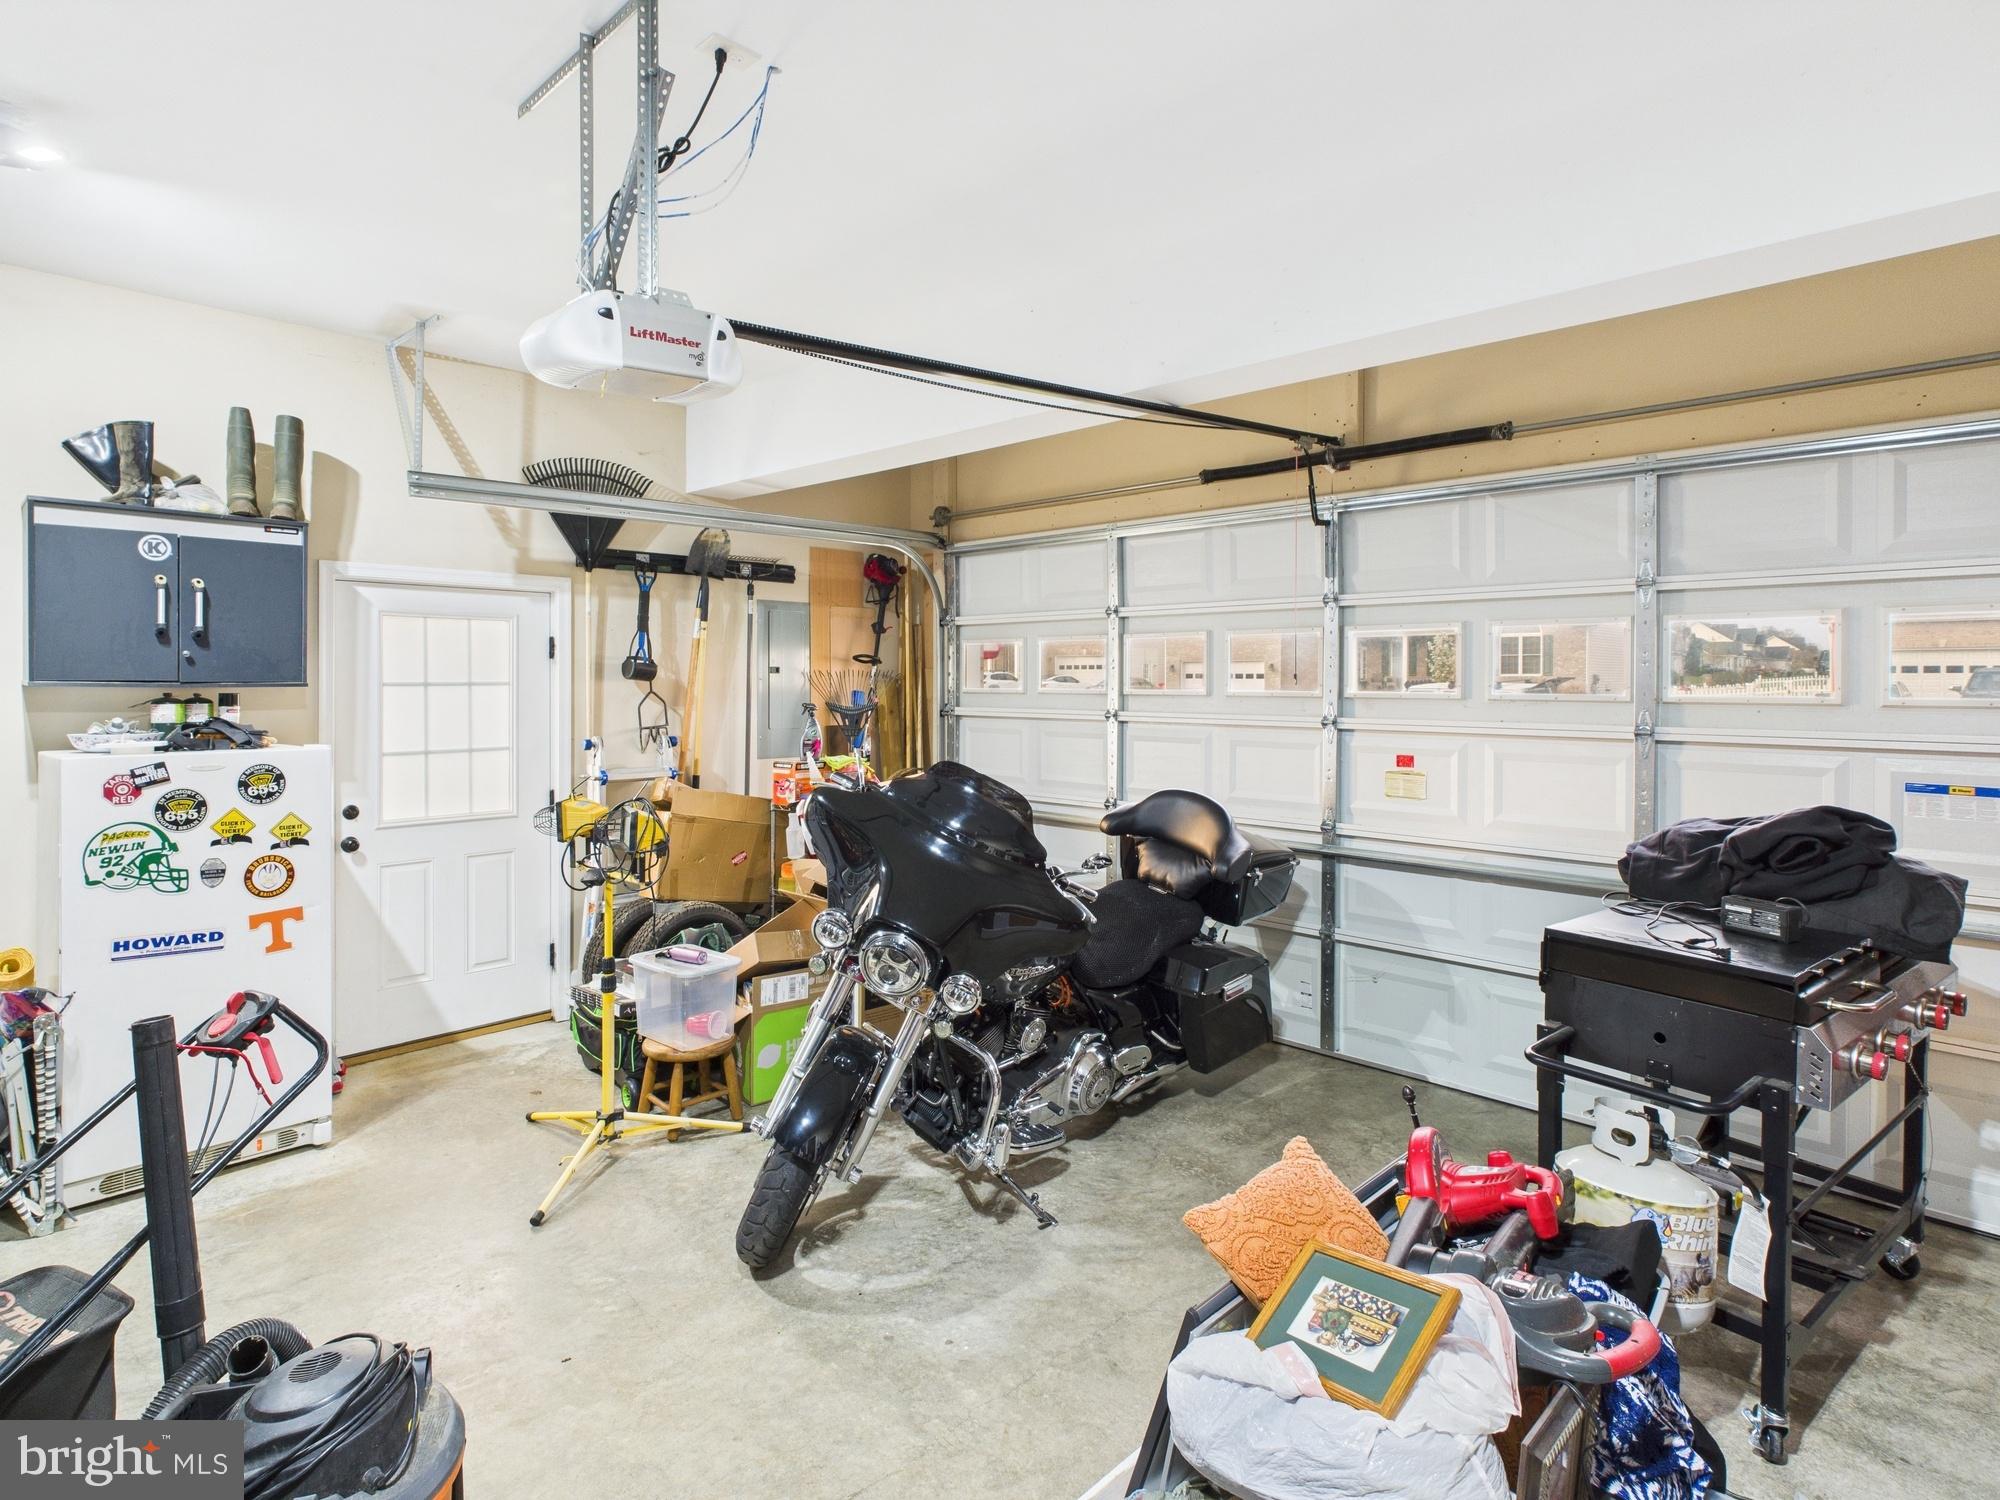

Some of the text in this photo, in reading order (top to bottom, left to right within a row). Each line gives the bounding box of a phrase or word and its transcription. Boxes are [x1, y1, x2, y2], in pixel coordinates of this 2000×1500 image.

[630, 326, 701, 348] LiftMaster
[164, 790, 196, 799] MEMORY
[247, 782, 279, 796] 655
[112, 795, 135, 804] RED
[156, 811, 178, 830] TROOPER
[164, 809, 199, 822] 655
[87, 841, 146, 857] NEWLIN
[99, 855, 125, 868] 92
[248, 906, 304, 953] T
[113, 931, 224, 952] HOWARD
[1672, 1214, 1715, 1233] Blue
[1668, 1233, 1715, 1252] Rhin
